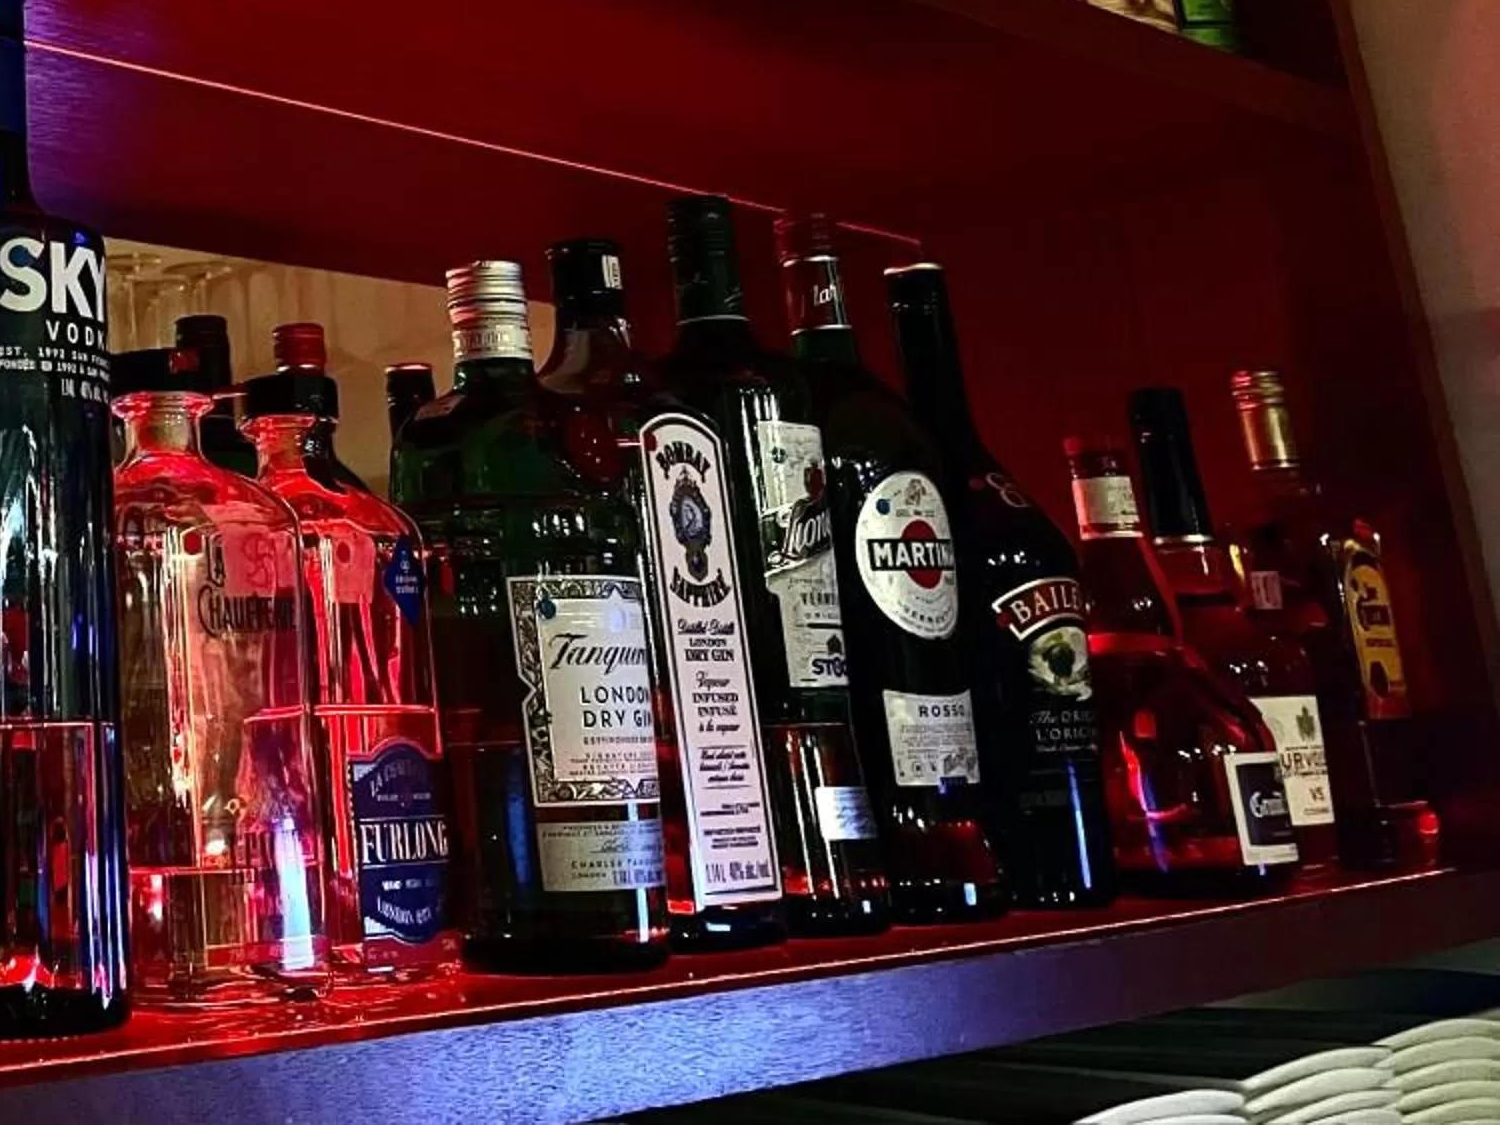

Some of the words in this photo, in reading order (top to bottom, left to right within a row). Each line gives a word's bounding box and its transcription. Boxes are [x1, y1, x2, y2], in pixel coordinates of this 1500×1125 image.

[655, 441, 711, 484] BOMBAY
[670, 566, 731, 608] SAPPHIRE
[689, 638, 727, 648] LONDON
[685, 648, 710, 662] DRY
[711, 648, 735, 662] GIN
[692, 692, 739, 704] INFUSED
[583, 710, 625, 727] DRY
[919, 704, 965, 718] ROSSO
[360, 819, 449, 864] FURLONG
